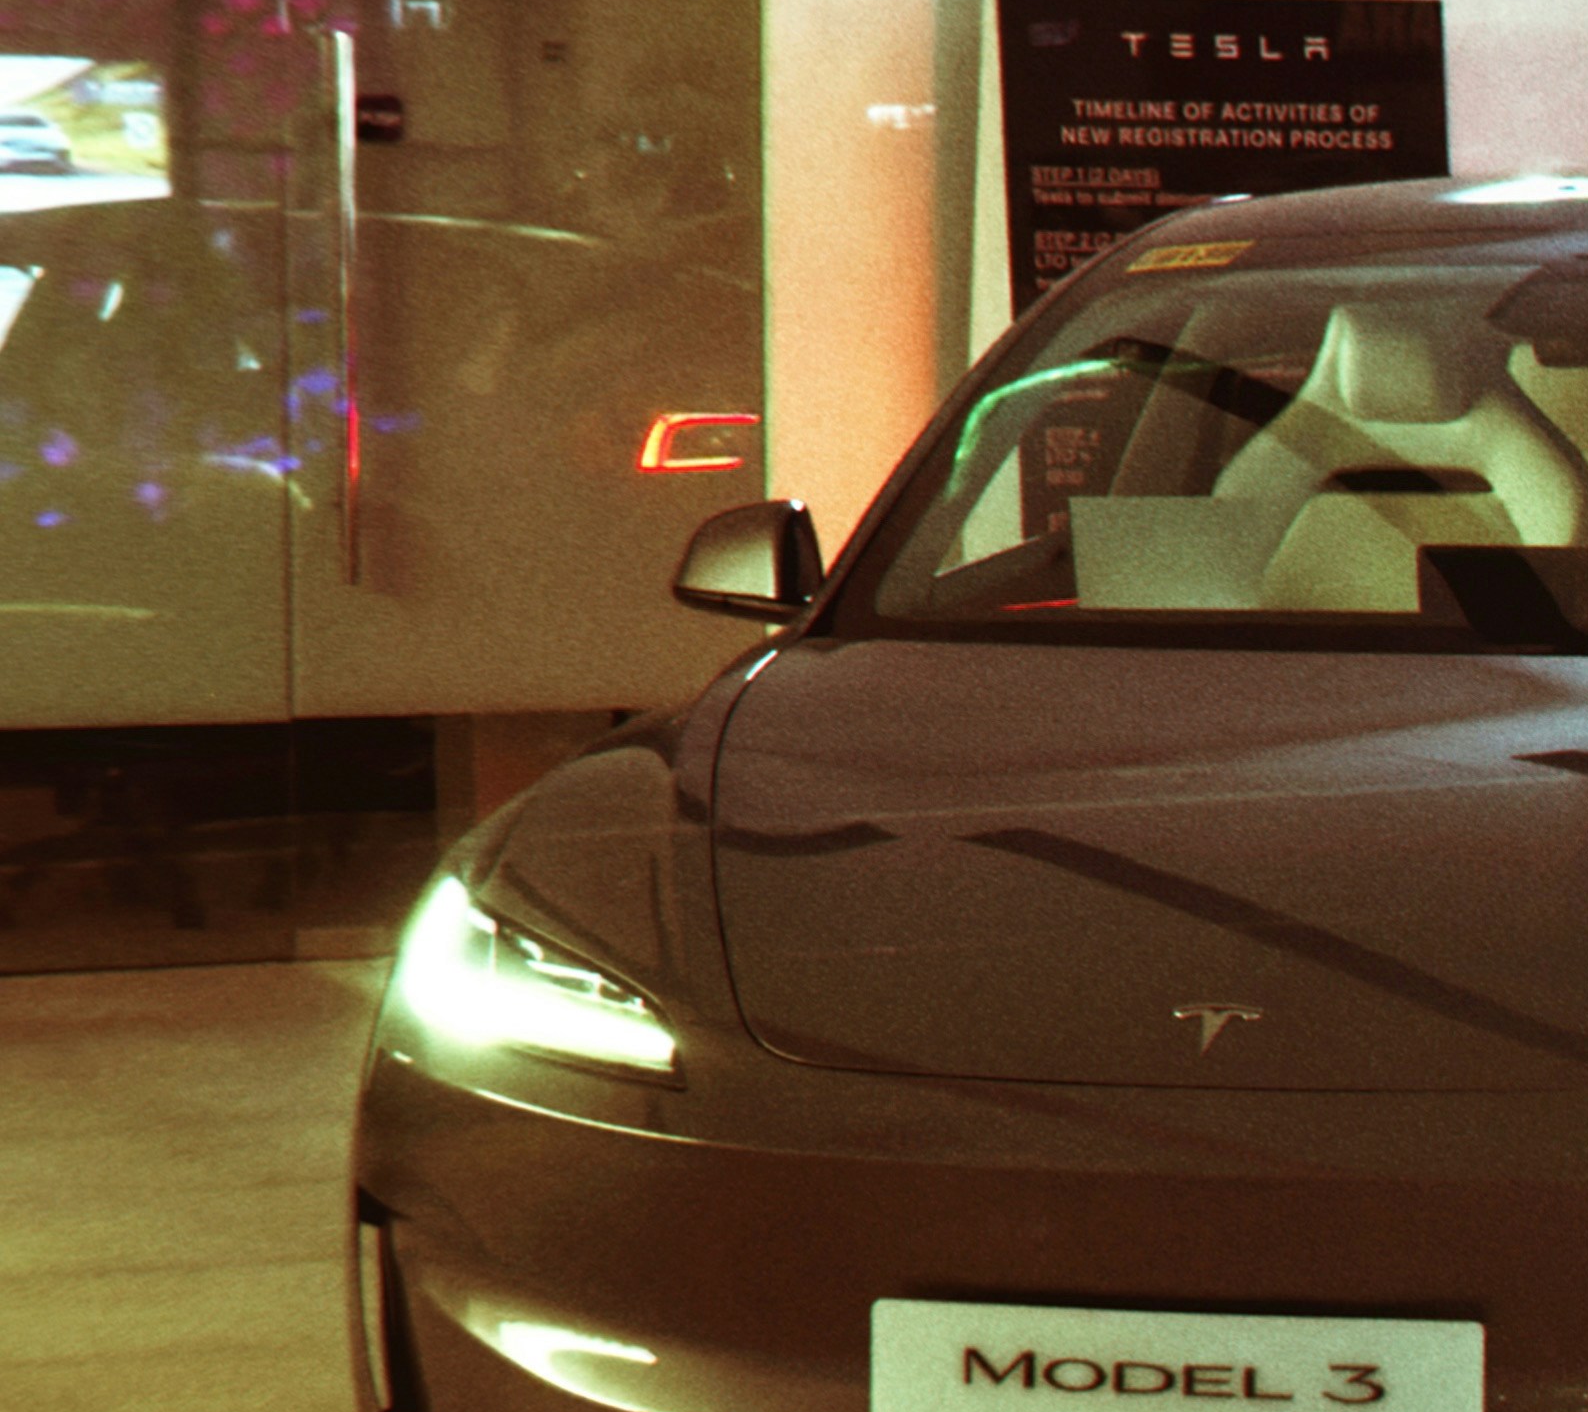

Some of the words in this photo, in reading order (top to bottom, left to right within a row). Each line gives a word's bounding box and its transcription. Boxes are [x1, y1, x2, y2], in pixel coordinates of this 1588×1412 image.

[1121, 31, 1331, 61] TESLA
[1072, 99, 1176, 121] TIMELINE
[1183, 103, 1214, 122] OF
[1221, 103, 1343, 124] ACTIVITIES
[1350, 105, 1380, 124] OF
[1060, 126, 1110, 146] NEW
[1118, 127, 1283, 148] REGISTRATION
[1290, 130, 1394, 150] PROCESS
[1031, 166, 1074, 185] STEP
[962, 1346, 1294, 1401] MODEL
[1321, 1363, 1387, 1406] 3
